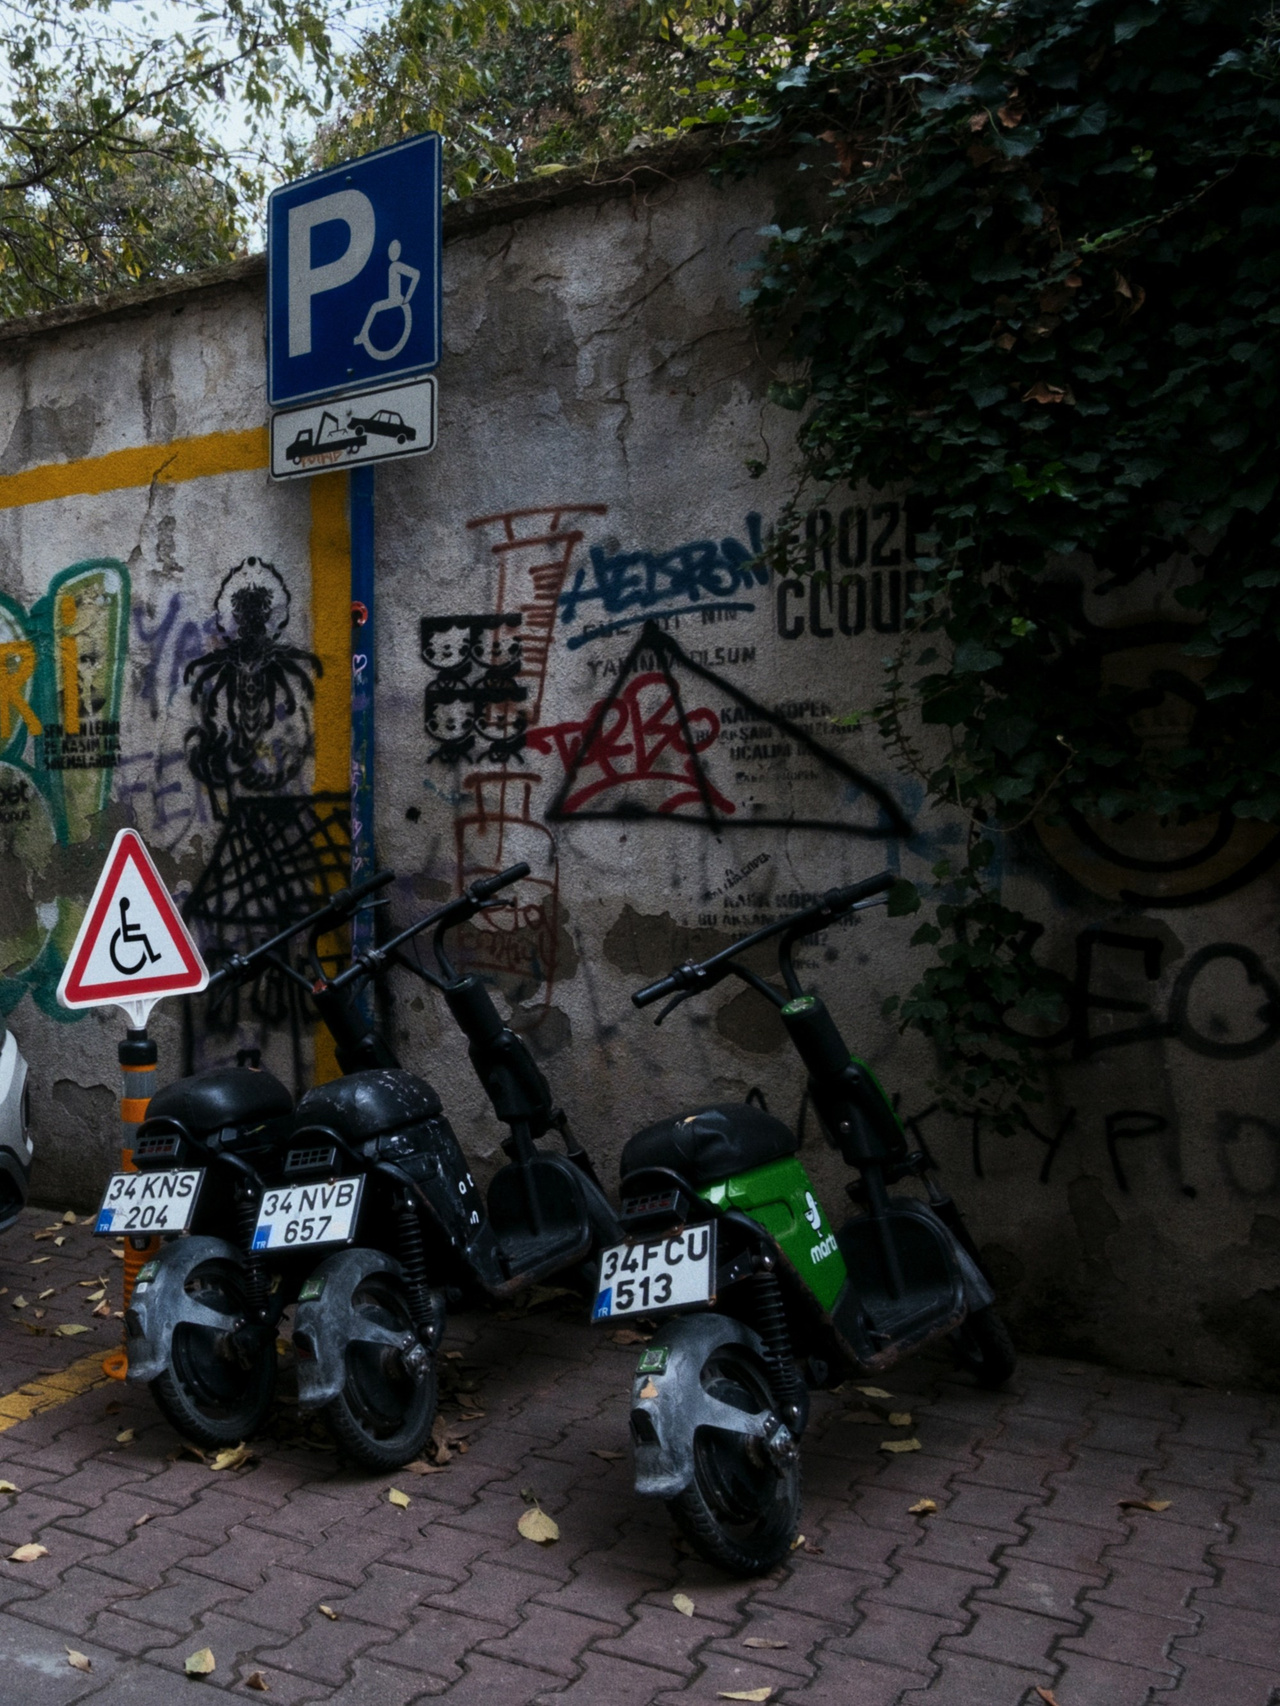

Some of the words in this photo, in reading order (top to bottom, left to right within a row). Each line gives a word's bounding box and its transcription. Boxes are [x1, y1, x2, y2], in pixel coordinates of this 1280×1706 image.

[288, 189, 376, 358] P
[109, 1177, 137, 1200] 34
[141, 1173, 195, 1199] KNS
[264, 1192, 293, 1217] 34
[298, 1182, 355, 1213] NVB
[124, 1204, 169, 1230] 204
[283, 1215, 332, 1244] 657
[615, 1272, 674, 1311] 513
